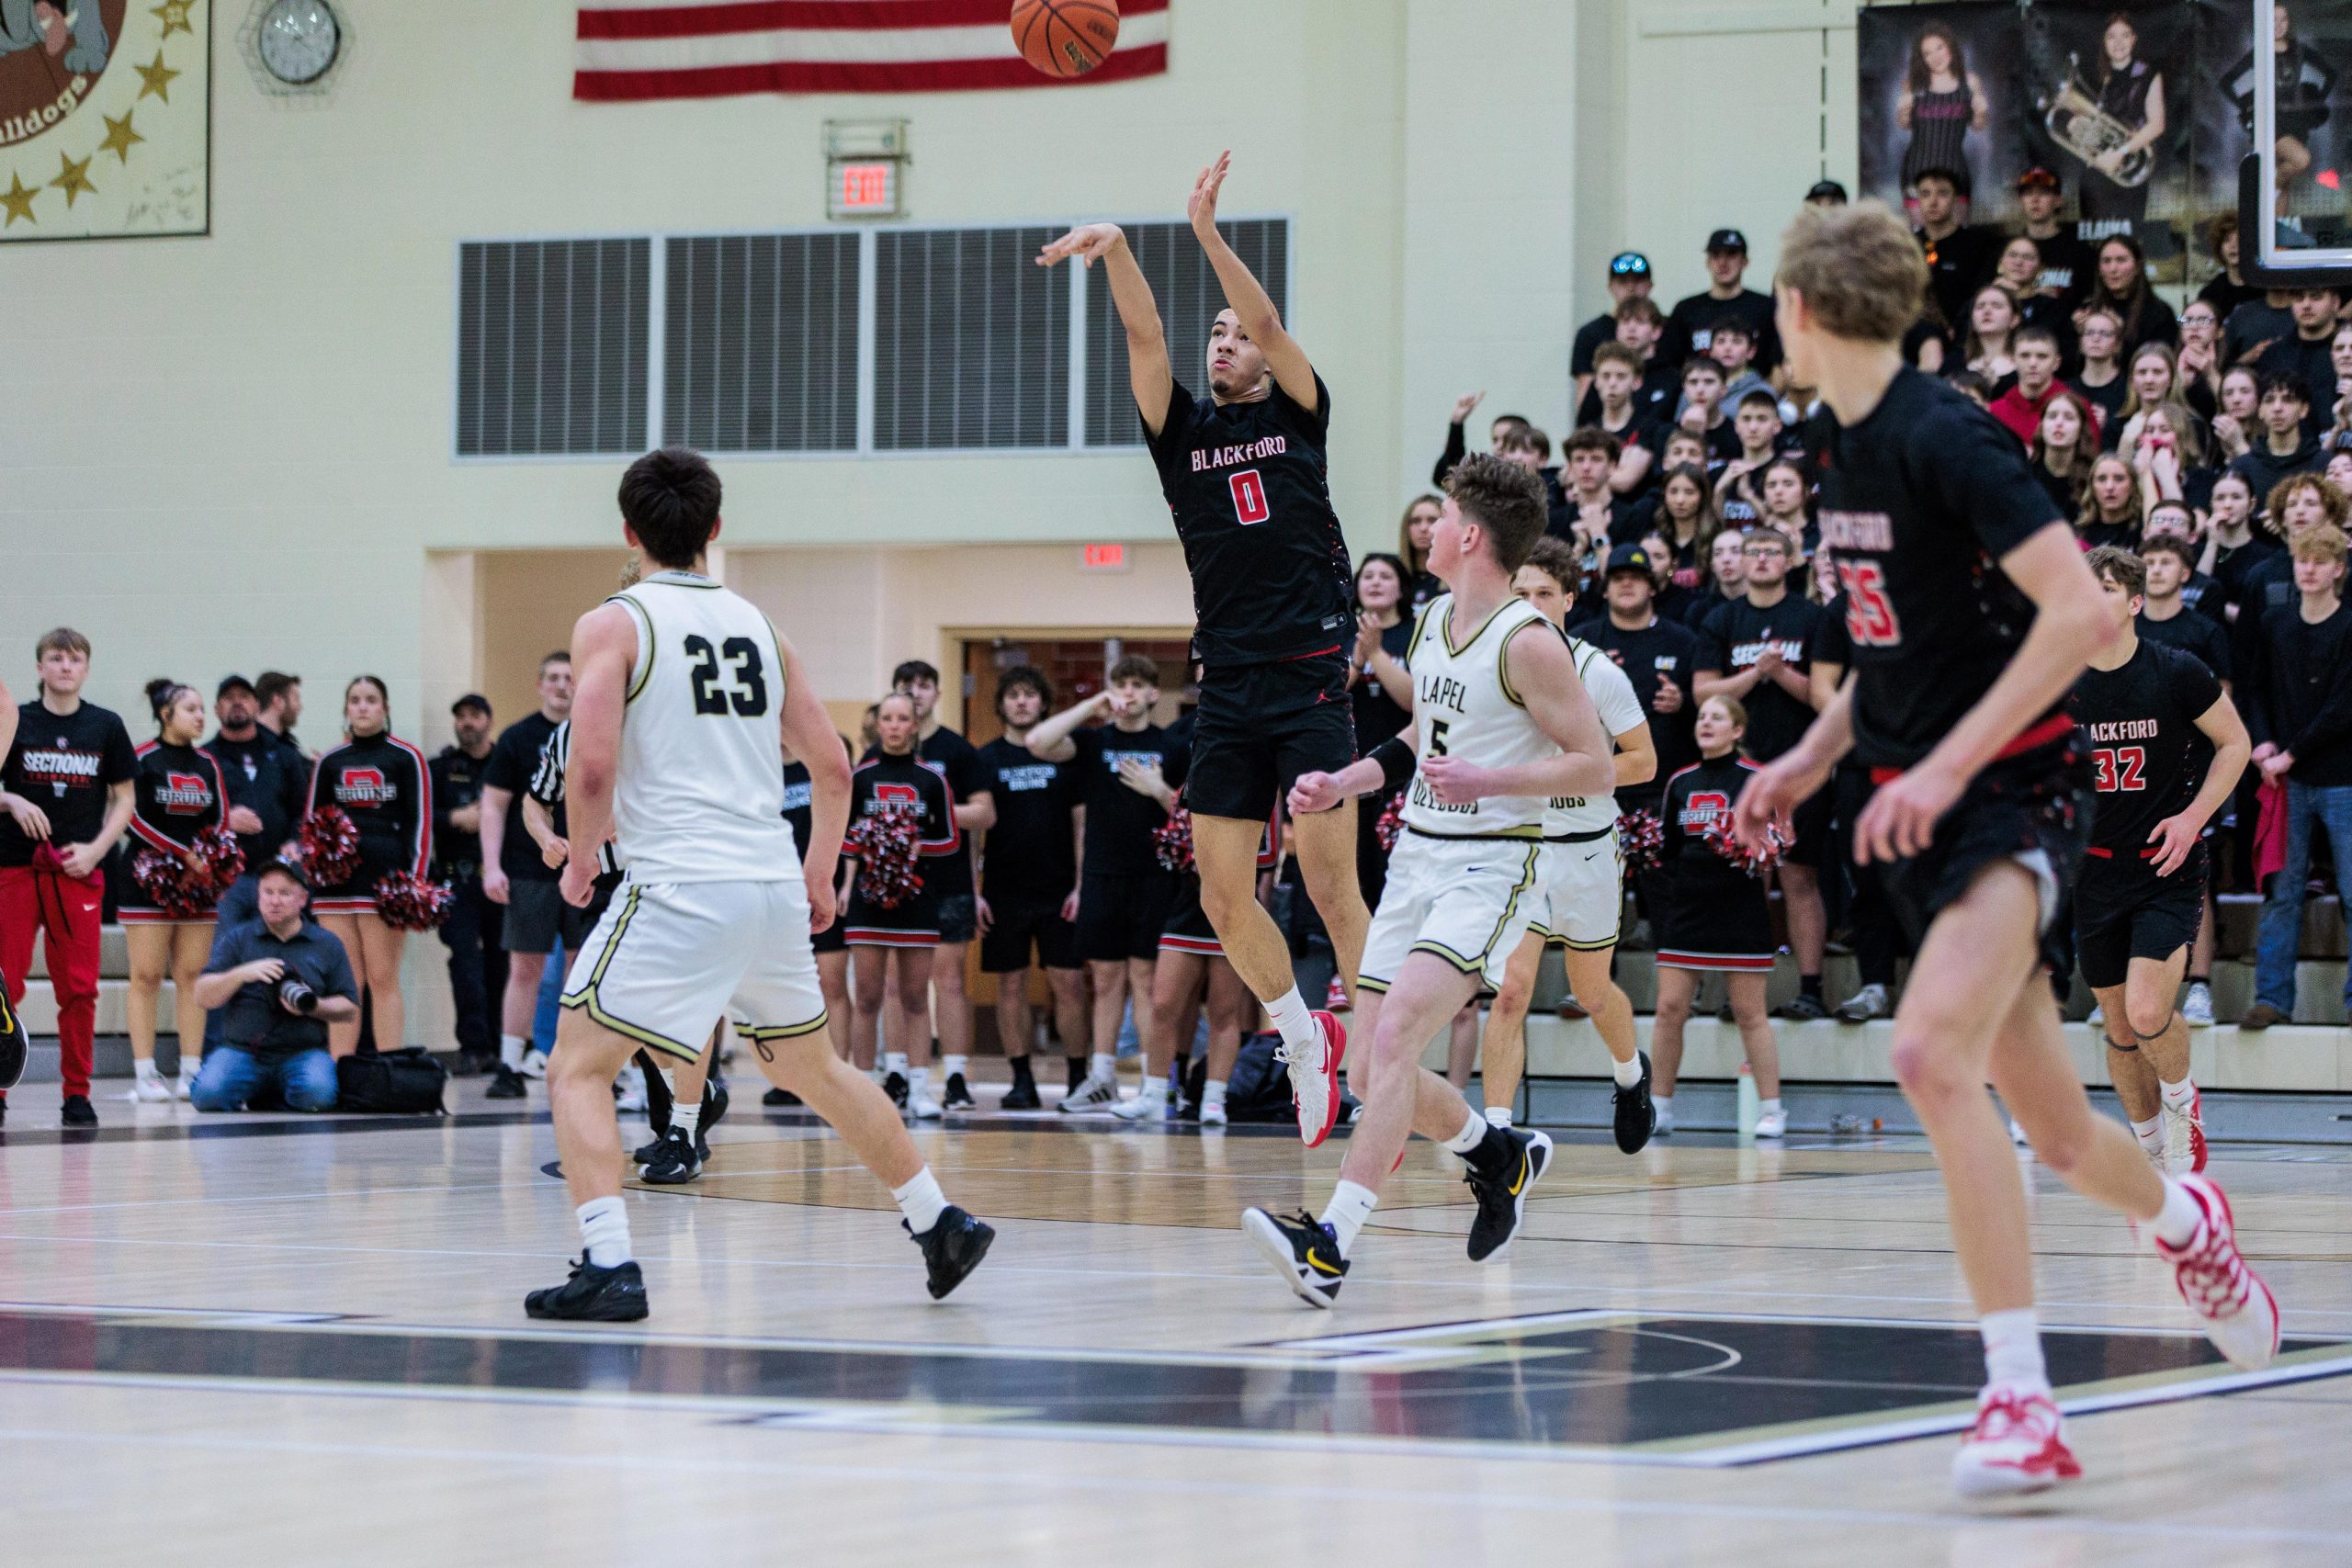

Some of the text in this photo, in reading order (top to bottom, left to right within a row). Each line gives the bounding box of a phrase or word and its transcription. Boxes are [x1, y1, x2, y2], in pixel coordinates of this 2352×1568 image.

[0, 75, 88, 145] lldogs
[843, 164, 888, 207] EXIT
[1191, 435, 1286, 472] BLACKFORD
[1228, 468, 1271, 525] 0
[683, 632, 768, 717] 23
[1421, 675, 1466, 715] LAPEL
[1427, 717, 1451, 759] 5
[23, 750, 100, 777] SECTIONAL
[2091, 746, 2146, 793] 32
